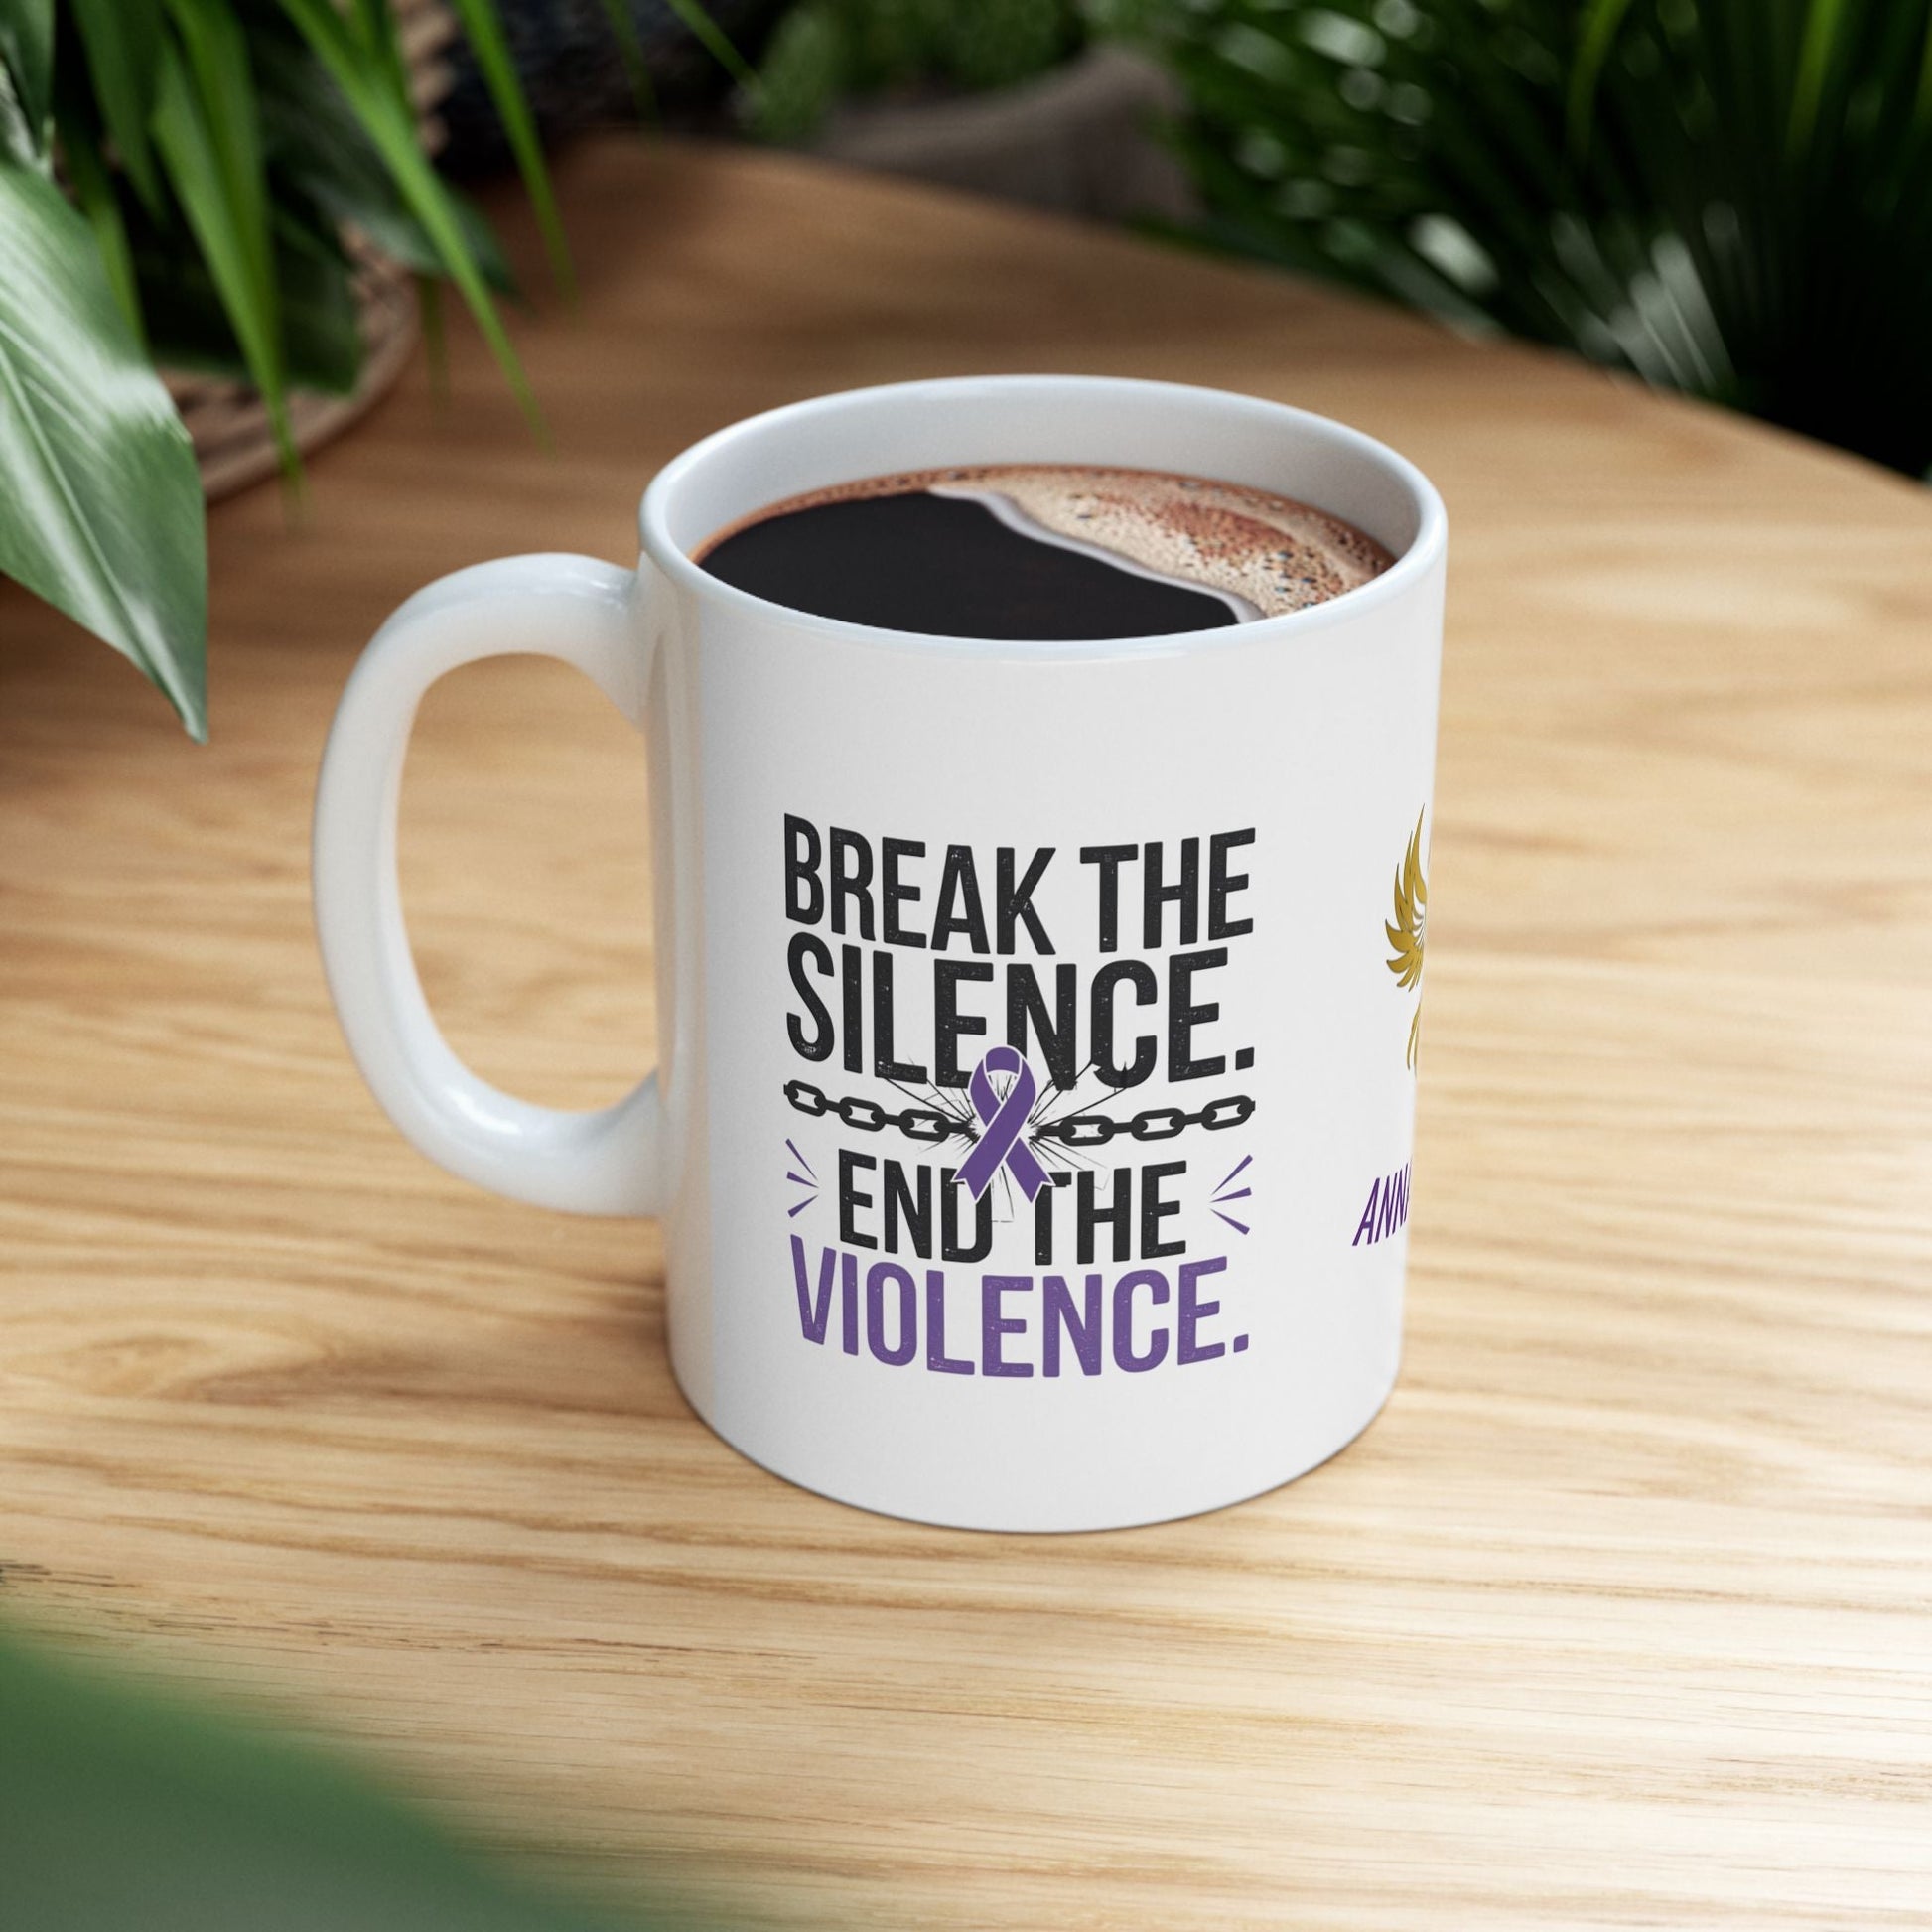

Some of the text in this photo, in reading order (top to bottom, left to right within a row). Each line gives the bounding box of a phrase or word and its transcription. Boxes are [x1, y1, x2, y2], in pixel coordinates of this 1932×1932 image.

[783, 812, 1257, 956] BREAK THE
[786, 931, 1256, 1092] SILENCE.
[838, 1148, 1188, 1266] END THE
[790, 1233, 1250, 1378] VIOLENCE.
